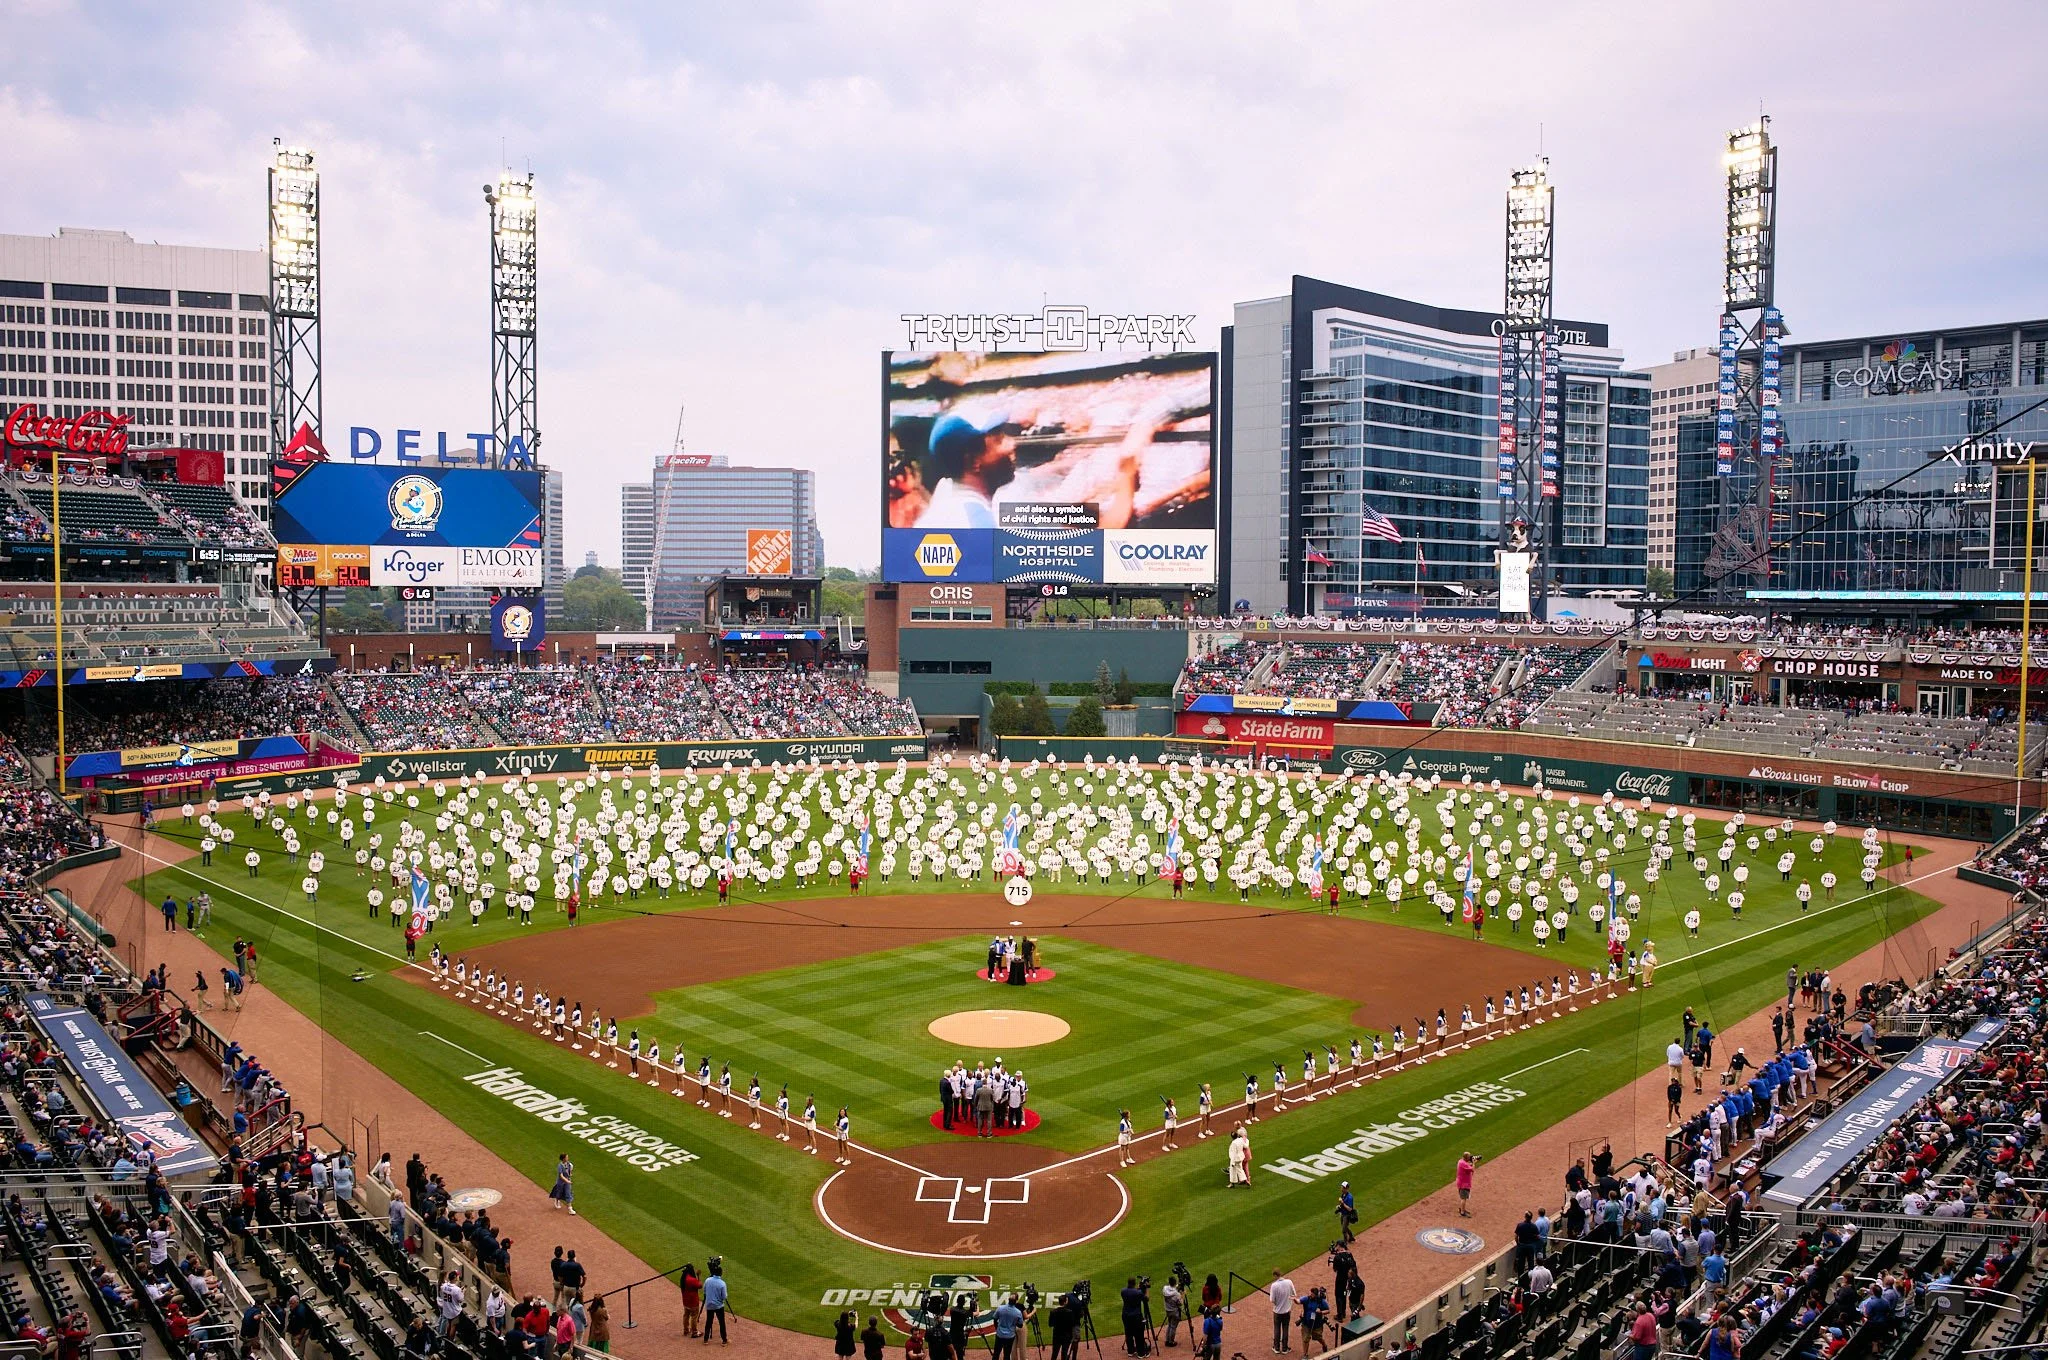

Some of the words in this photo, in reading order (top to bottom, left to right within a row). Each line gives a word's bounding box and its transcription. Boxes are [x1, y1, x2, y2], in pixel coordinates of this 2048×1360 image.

[901, 314, 1034, 344] TRUIST
[1098, 314, 1197, 344] PARK
[1834, 358, 1969, 388] COMCAST
[350, 427, 532, 467] DELTA
[1941, 436, 2035, 467] xfinity
[1015, 505, 1030, 513] and
[1031, 505, 1048, 513] also
[1055, 505, 1084, 514] symbol
[1002, 515, 1010, 523] of
[1011, 515, 1027, 523] civil
[1029, 515, 1051, 524] rights
[1052, 515, 1067, 523] and
[752, 534, 771, 552] THE
[80, 548, 128, 556] POWERADE
[200, 550, 220, 560] 6:55
[293, 550, 317, 558] MEGA
[462, 549, 538, 566] EMORY
[748, 530, 792, 574] HOME
[923, 546, 954, 565] NAPA
[1003, 545, 1094, 557] NORTHSIDE
[1119, 544, 1208, 560] COOLRAY
[384, 550, 444, 582] Kroger
[764, 547, 792, 574] DEPOT
[1019, 558, 1078, 566] HOSPITAL
[416, 589, 431, 599] LG
[930, 586, 973, 600] ORIS
[1054, 586, 1068, 596] LG
[1354, 597, 1388, 607] Braves
[1654, 652, 1691, 668] Coors
[1691, 658, 1727, 670] LIGHT
[1774, 661, 1817, 674] CHOP
[1823, 662, 1880, 677] HOUSE
[1941, 669, 1975, 679] MADE
[1978, 670, 1994, 680] TO
[140, 752, 177, 760] ANNIVERSARY
[687, 749, 755, 761] EQUIFAX
[810, 744, 864, 754] HYUNDAI
[496, 751, 559, 774] xfinity
[585, 750, 657, 763] QUIKRETE
[1350, 753, 1378, 767] Ford
[409, 761, 466, 773] Wellstar
[1294, 761, 1320, 769] National
[1419, 760, 1457, 774] Georgia
[1459, 762, 1490, 774] Power
[142, 770, 184, 785] AMERICA'S
[184, 769, 220, 781] LARGEST
[221, 768, 227, 776] &
[269, 760, 305, 770] NETWORK
[1546, 768, 1566, 777] KAISER
[1761, 766, 1792, 781] Coors
[1793, 774, 1823, 784] LIGHT
[1546, 777, 1586, 788] PERMANENTE
[1616, 771, 1673, 797] Coca-Cola
[1833, 775, 1868, 788] BELOW
[1881, 780, 1909, 792] CHOP
[2003, 808, 2016, 816] 325
[1008, 886, 1028, 895] 715
[1534, 899, 1547, 907] 709
[1554, 916, 1566, 925] 638
[1686, 916, 1698, 924] 714
[75, 1038, 106, 1060] TRUIST
[96, 1066, 125, 1084] PARK
[1397, 1081, 1503, 1121] CHEROKEE
[1422, 1088, 1527, 1129] CASINOS
[115, 1112, 199, 1150] Braves
[590, 1115, 701, 1165] CHEROKEE
[1792, 1156, 1826, 1179] WELCOME
[1822, 1123, 1867, 1150] TRUIST
[1862, 1098, 1898, 1117] PARK
[562, 1121, 671, 1173] CASINOS
[1700, 1166, 1704, 1174] 4
